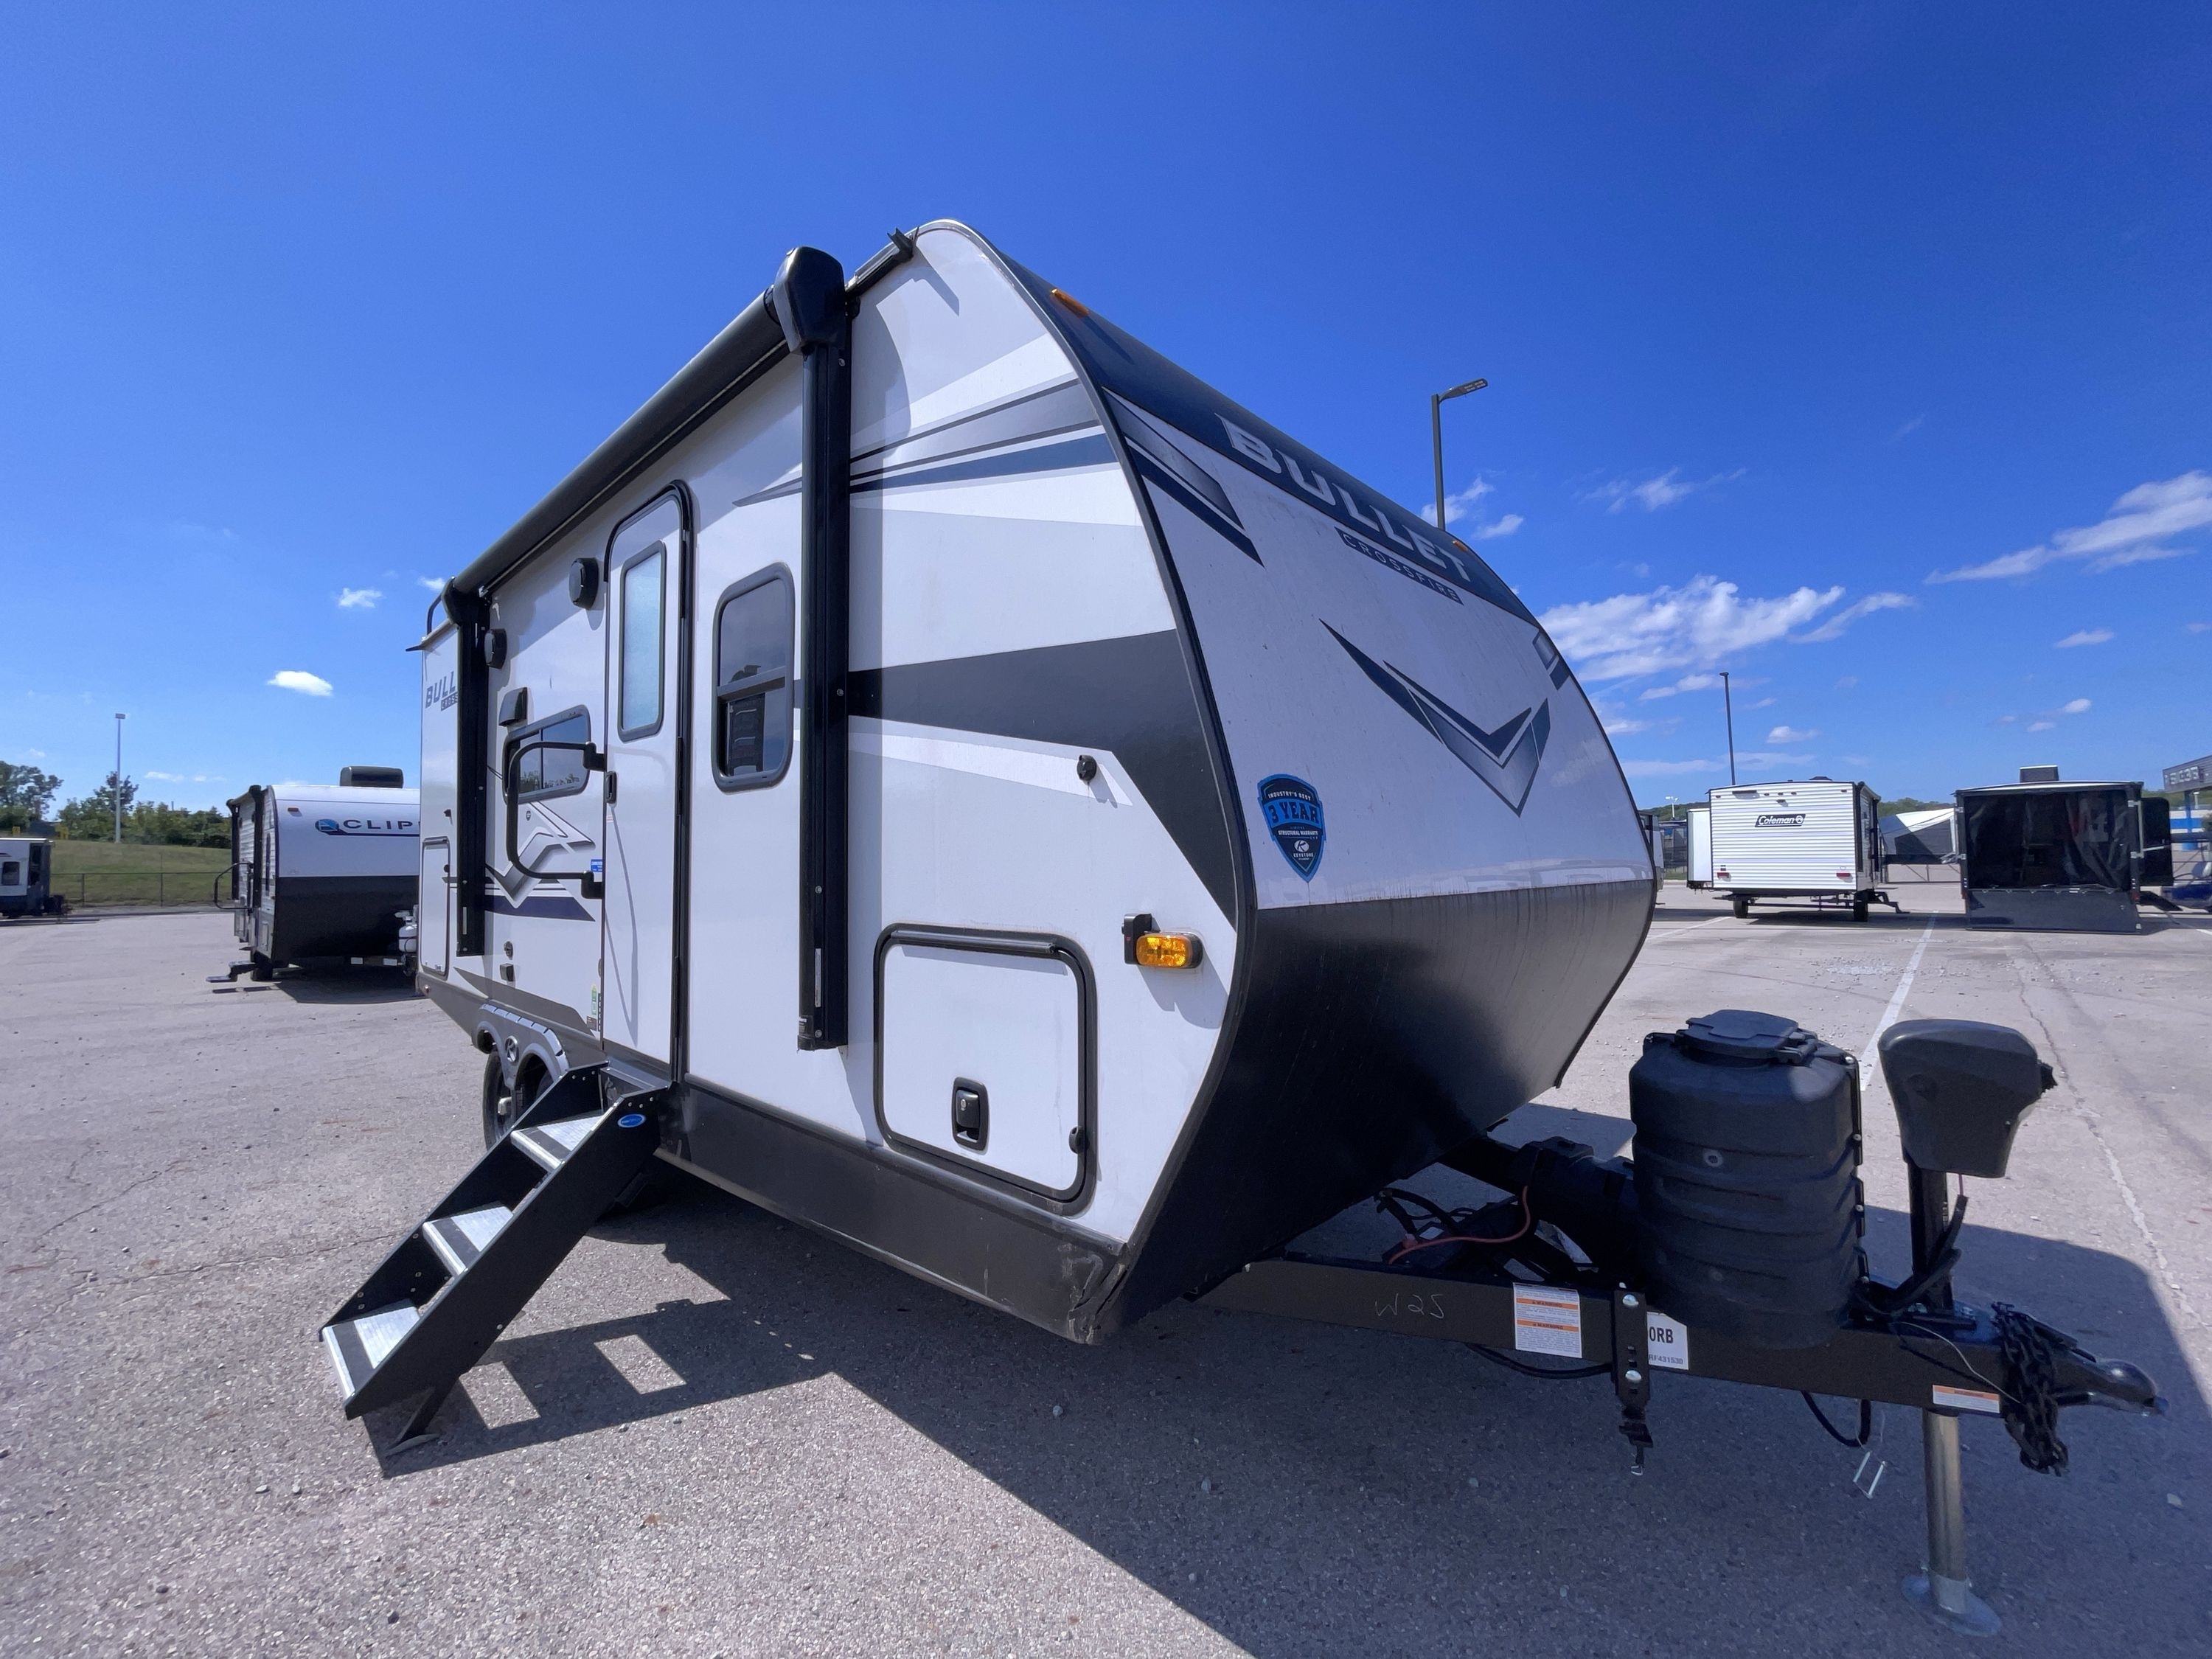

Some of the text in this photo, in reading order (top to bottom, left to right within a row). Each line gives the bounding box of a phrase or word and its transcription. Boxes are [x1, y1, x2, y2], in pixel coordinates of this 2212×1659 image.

[1214, 412, 1470, 582] BULLET
[1342, 532, 1460, 604] CROSSFIRE
[425, 671, 456, 709] BULL
[343, 819, 420, 830] CLIP
[1267, 801, 1320, 824] 3 YEAR
[1758, 815, 1795, 825] Coleman
